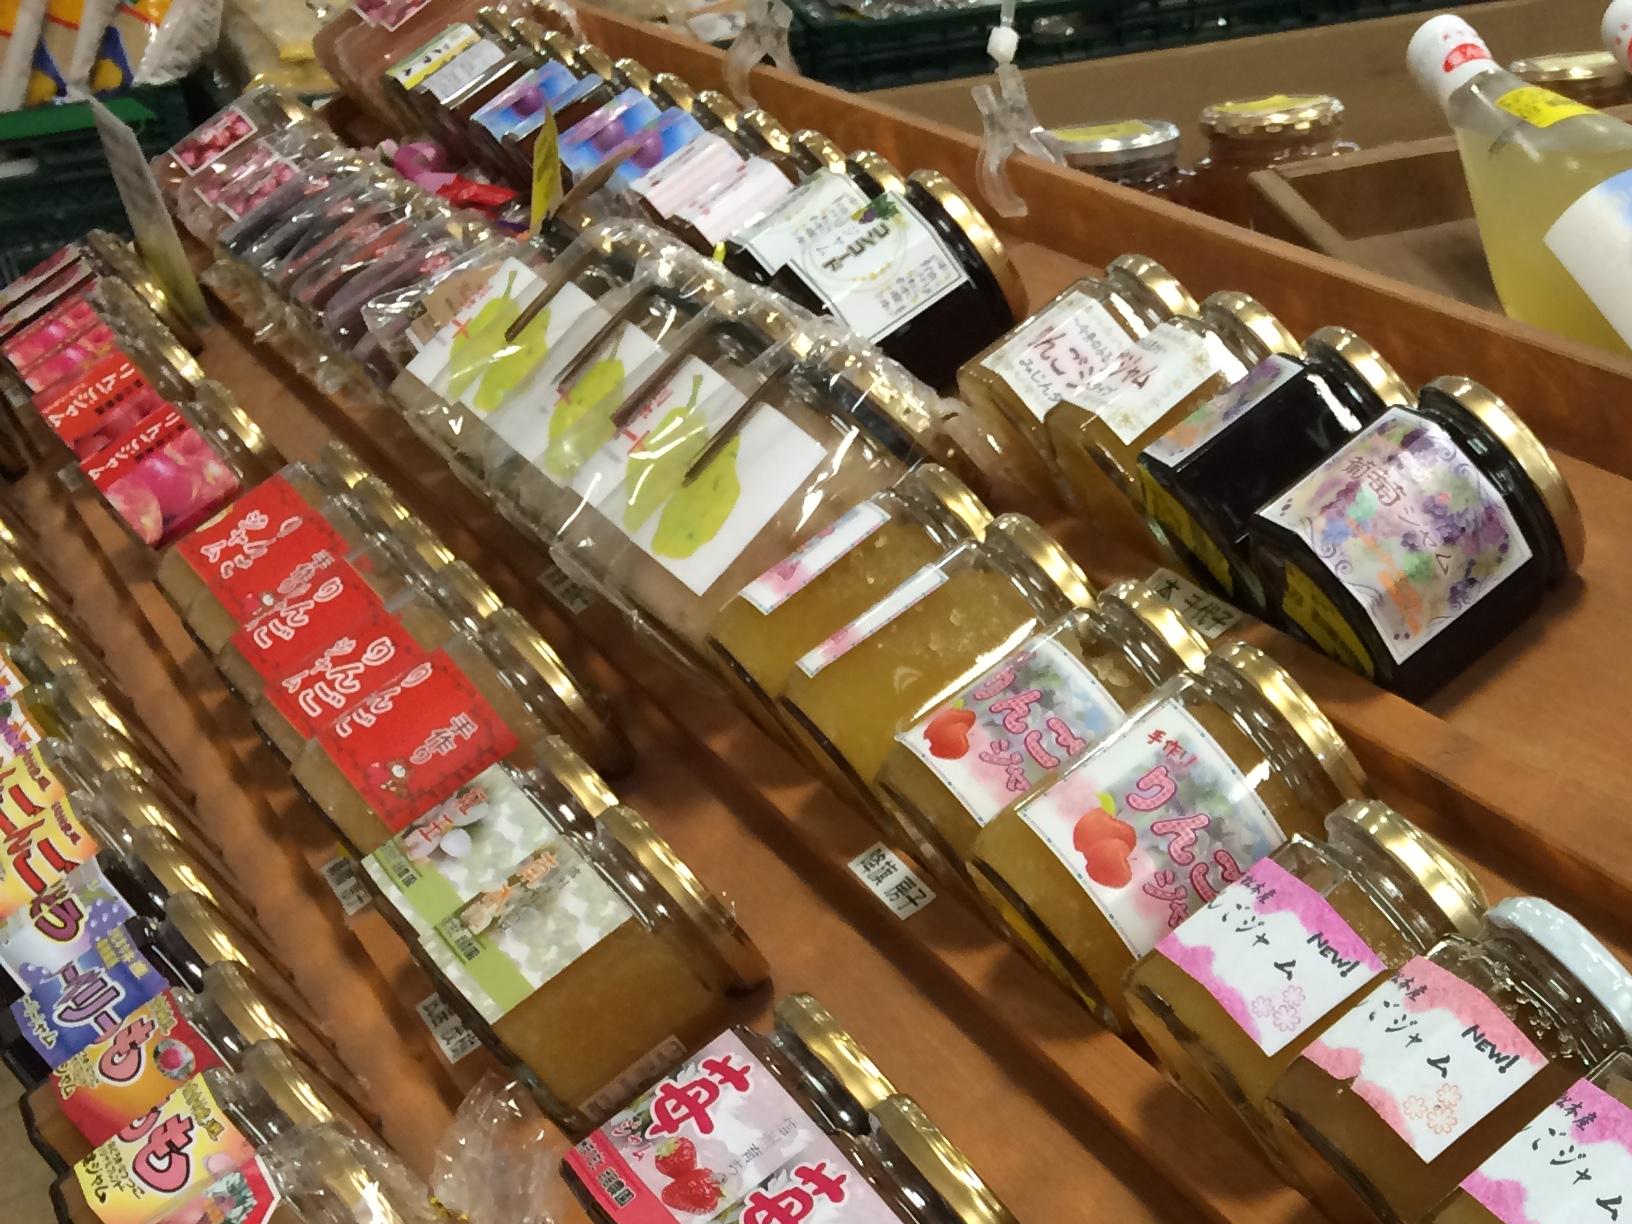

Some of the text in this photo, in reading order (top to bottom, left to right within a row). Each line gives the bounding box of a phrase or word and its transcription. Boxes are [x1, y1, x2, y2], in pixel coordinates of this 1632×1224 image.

[298, 635, 396, 718] りんご
[647, 1054, 752, 1136] 苺
